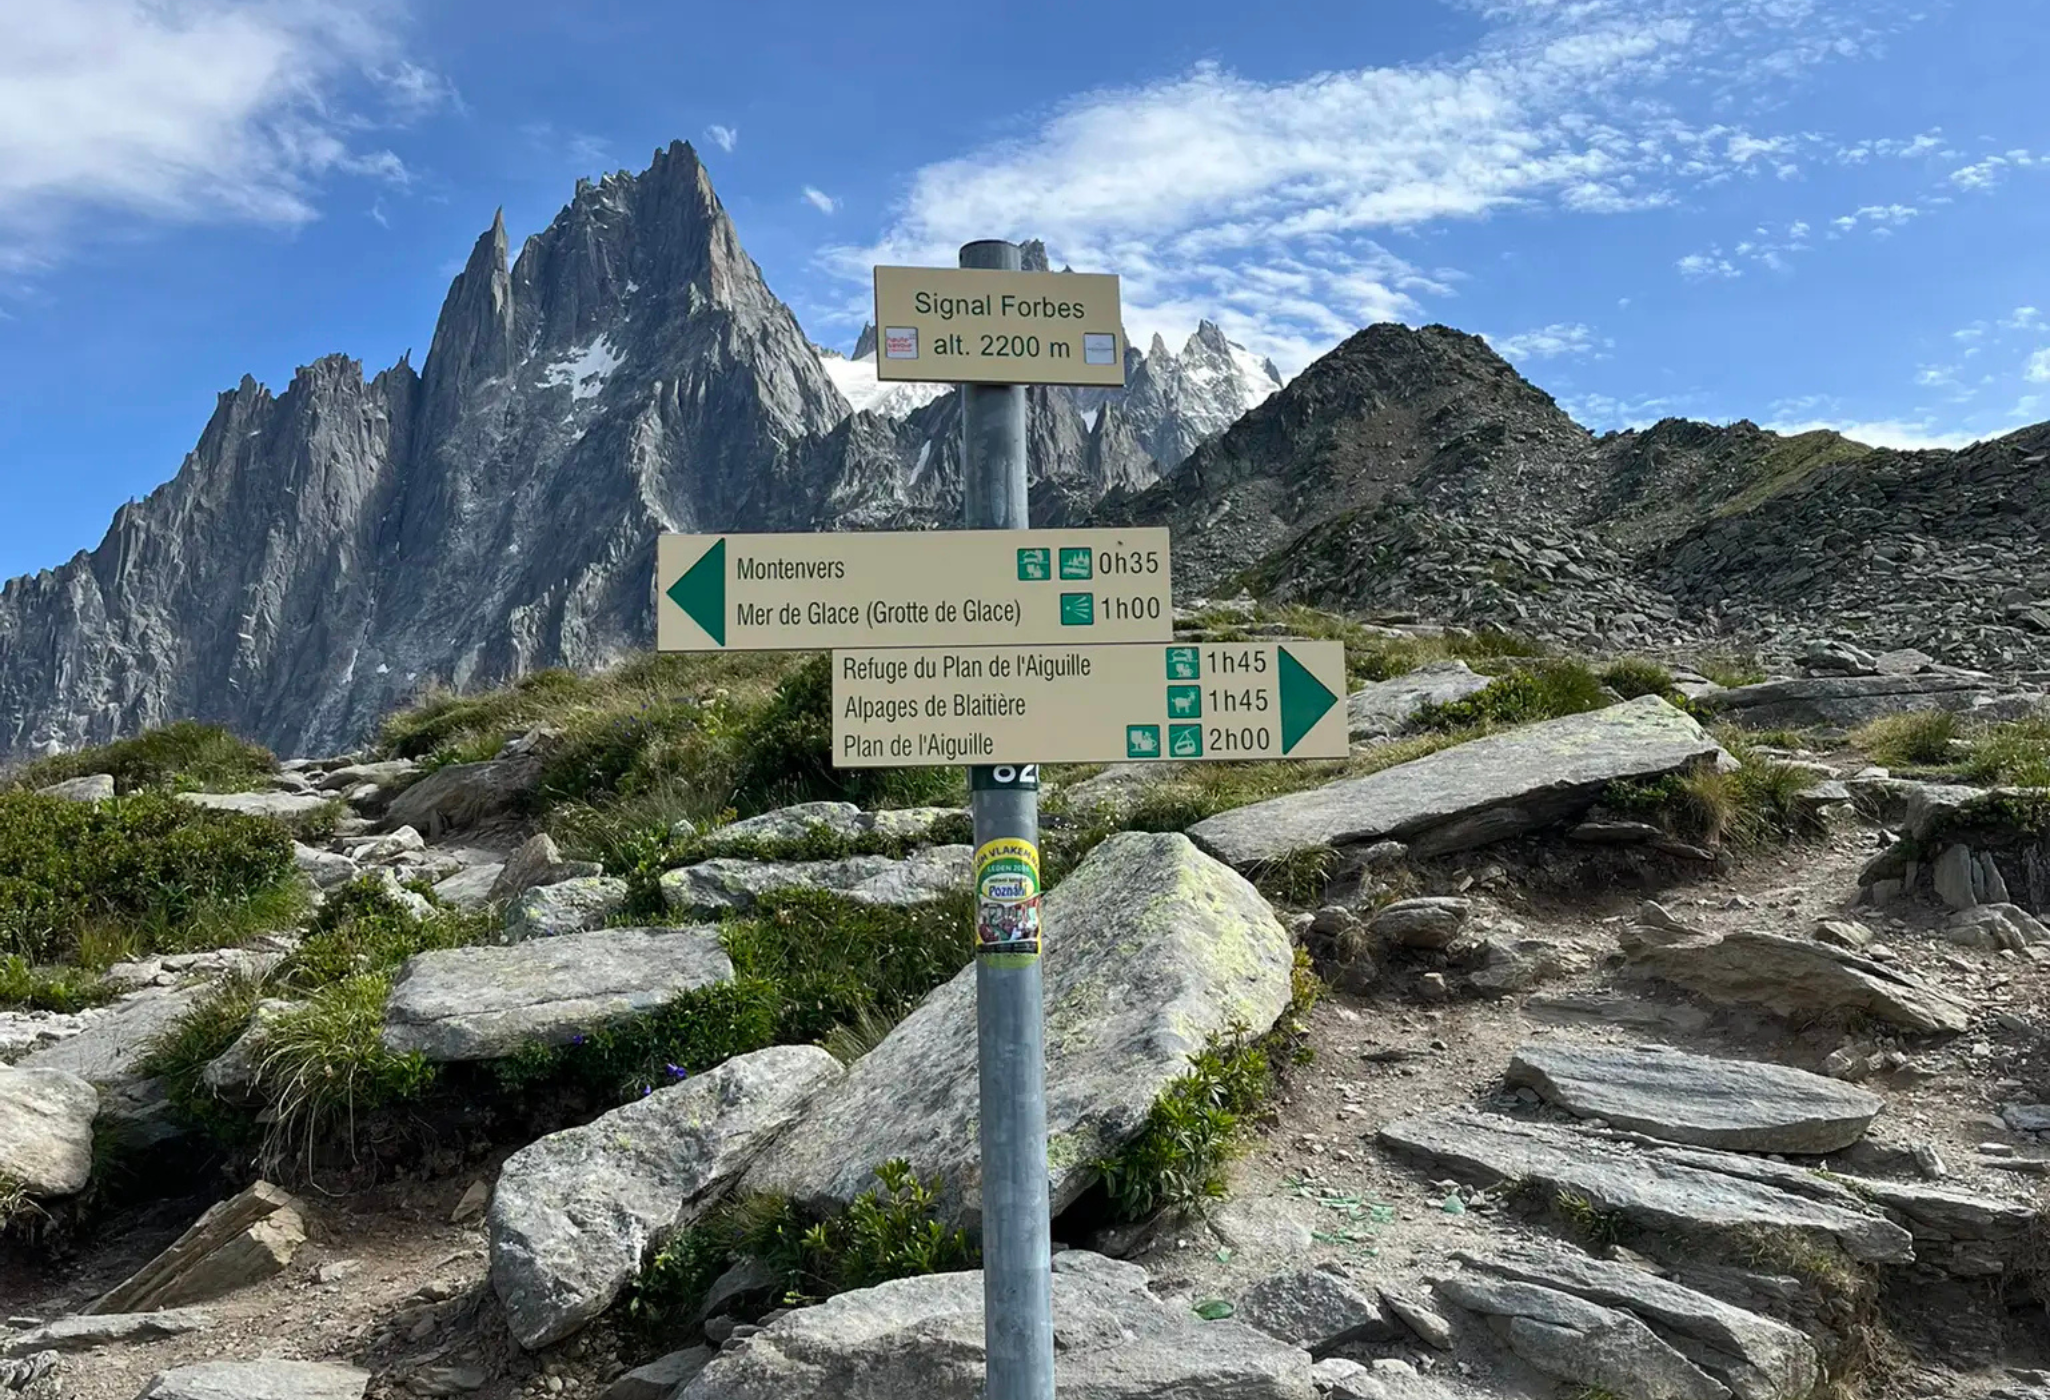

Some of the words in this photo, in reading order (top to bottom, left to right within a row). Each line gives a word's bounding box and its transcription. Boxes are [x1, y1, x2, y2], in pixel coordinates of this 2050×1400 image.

[915, 291, 991, 320] Signal
[1001, 295, 1085, 319] Forbes
[933, 334, 970, 355] alt.
[980, 334, 1040, 357] 2200
[1049, 341, 1070, 358] m
[737, 557, 845, 580] Montenvers
[1099, 551, 1159, 574] 0h35
[737, 603, 774, 626] Mer
[779, 602, 801, 625] de
[807, 601, 859, 625] Glace
[866, 600, 929, 629] (Grotte
[935, 600, 957, 623] de
[963, 599, 1021, 627] Glace)
[1101, 596, 1160, 620] 1h00
[843, 656, 908, 683] Refuge
[913, 656, 936, 679] du
[943, 655, 983, 678] Plan
[988, 655, 1011, 678] de
[1016, 653, 1091, 682] l'Aiguille
[1207, 650, 1267, 674] 1h45
[844, 696, 918, 724] Alpages
[924, 695, 947, 718] de
[953, 692, 1026, 717] Blaitière
[1208, 688, 1269, 712] 1h45
[843, 735, 884, 758] Plan
[889, 734, 913, 757] de
[918, 732, 994, 760] l'Aiguille
[1209, 727, 1270, 751] 2h00
